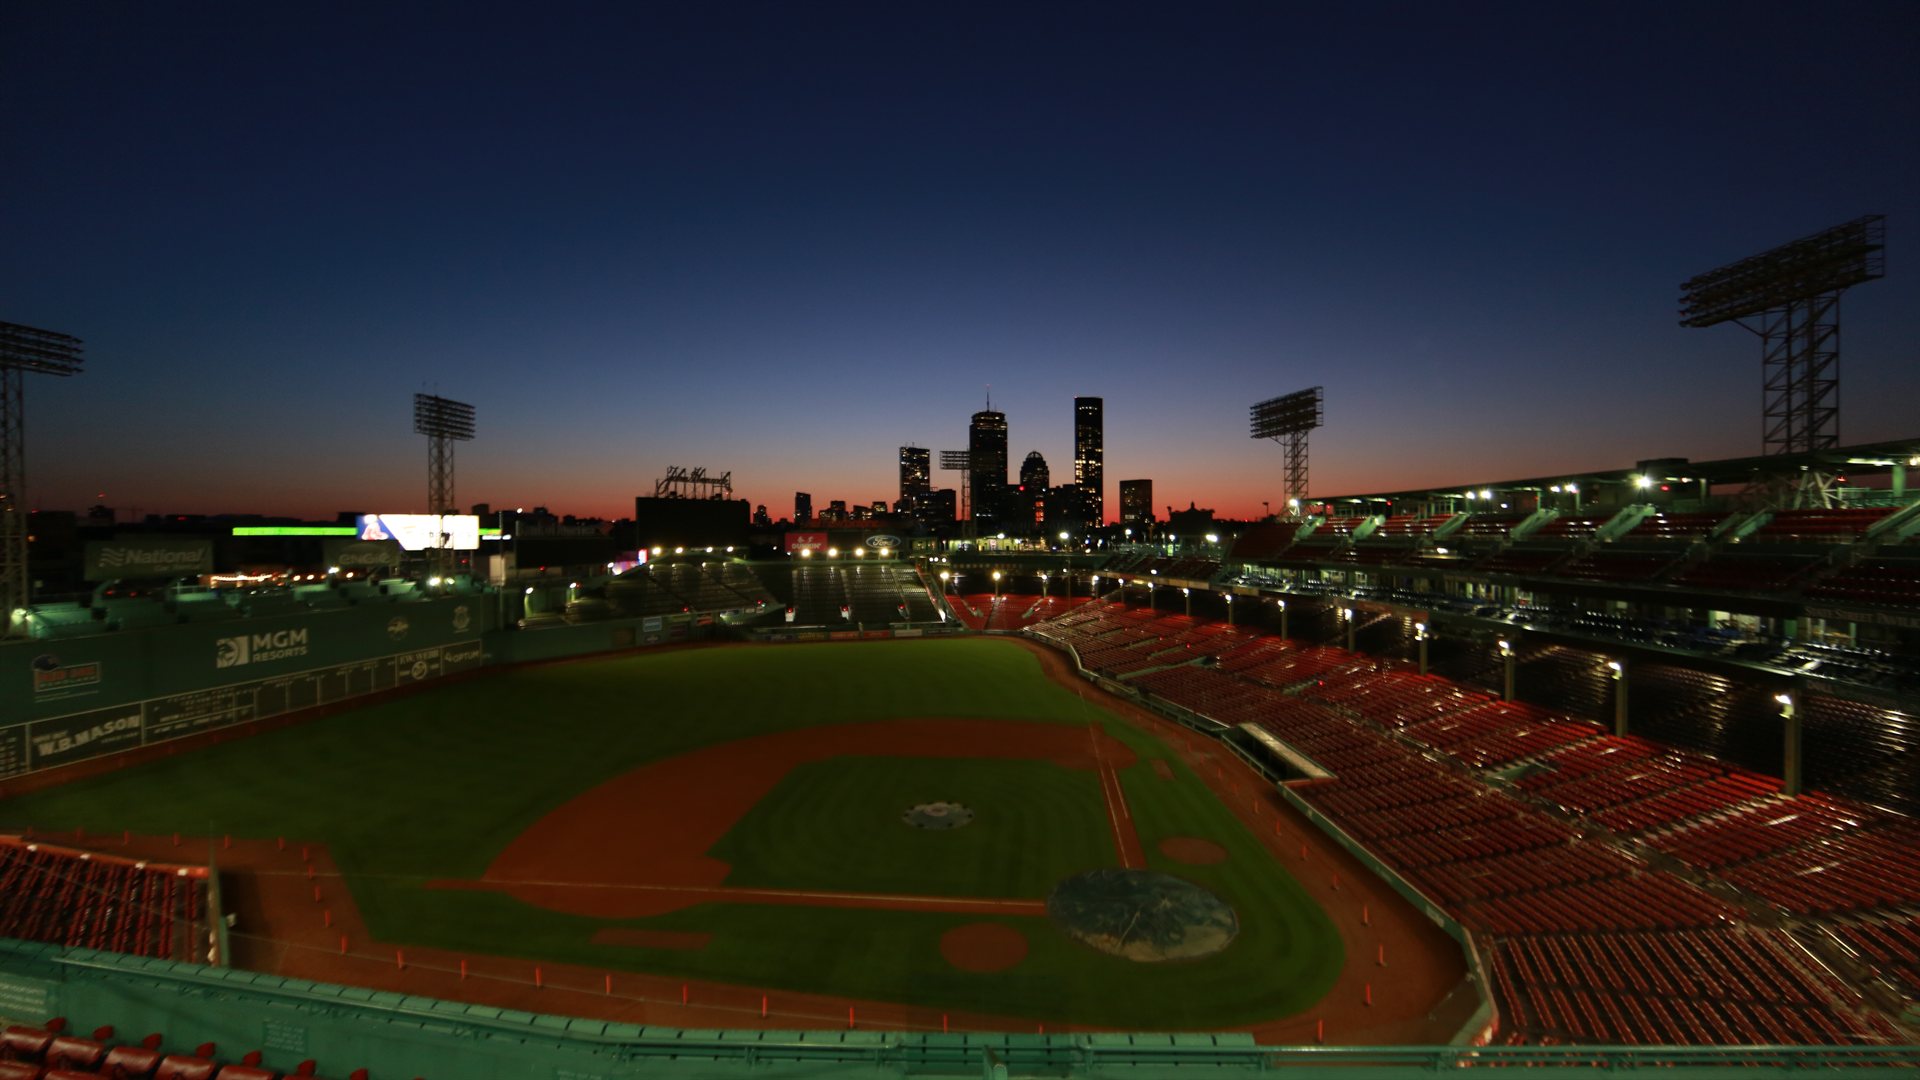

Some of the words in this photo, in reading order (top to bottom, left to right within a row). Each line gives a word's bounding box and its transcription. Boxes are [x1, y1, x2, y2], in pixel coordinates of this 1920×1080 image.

[657, 466, 690, 495] John
[872, 537, 895, 546] Ford
[125, 547, 204, 564] National
[252, 628, 309, 651] MGM
[252, 646, 309, 663] RESORTS
[74, 714, 141, 746] MASON
